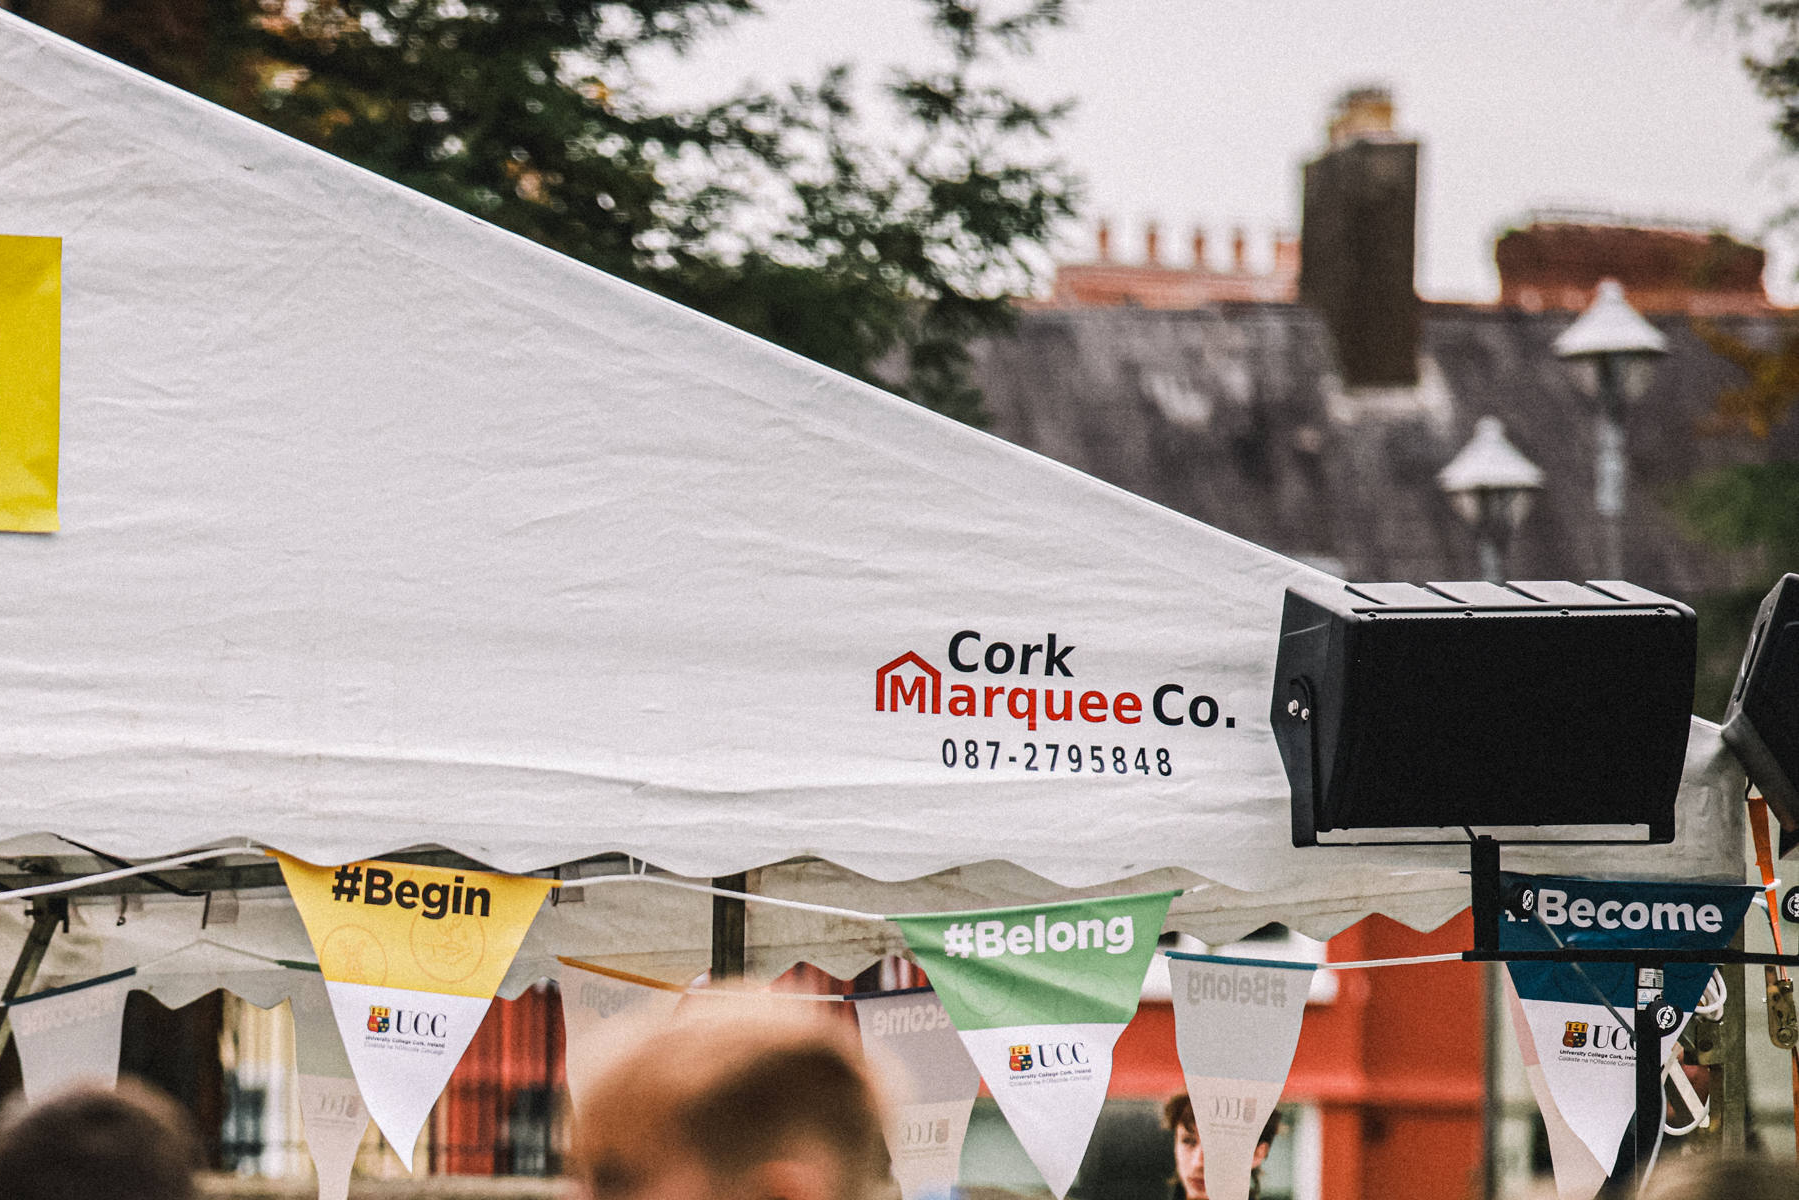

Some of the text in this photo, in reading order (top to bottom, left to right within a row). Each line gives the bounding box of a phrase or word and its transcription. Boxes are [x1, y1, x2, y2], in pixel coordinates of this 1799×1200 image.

[948, 629, 1077, 678] Cork
[889, 672, 1236, 731] Marquee Co.
[941, 738, 1173, 777] 087-2795848
[332, 865, 491, 920] #Begin
[943, 914, 1135, 959] #Belong
[396, 1008, 447, 1038] UCC
[1036, 1041, 1089, 1068] UCC
[1559, 1049, 1586, 1057] University
[1587, 1051, 1608, 1059] College
[1009, 1073, 1037, 1081] University
[1038, 1071, 1058, 1079] College
